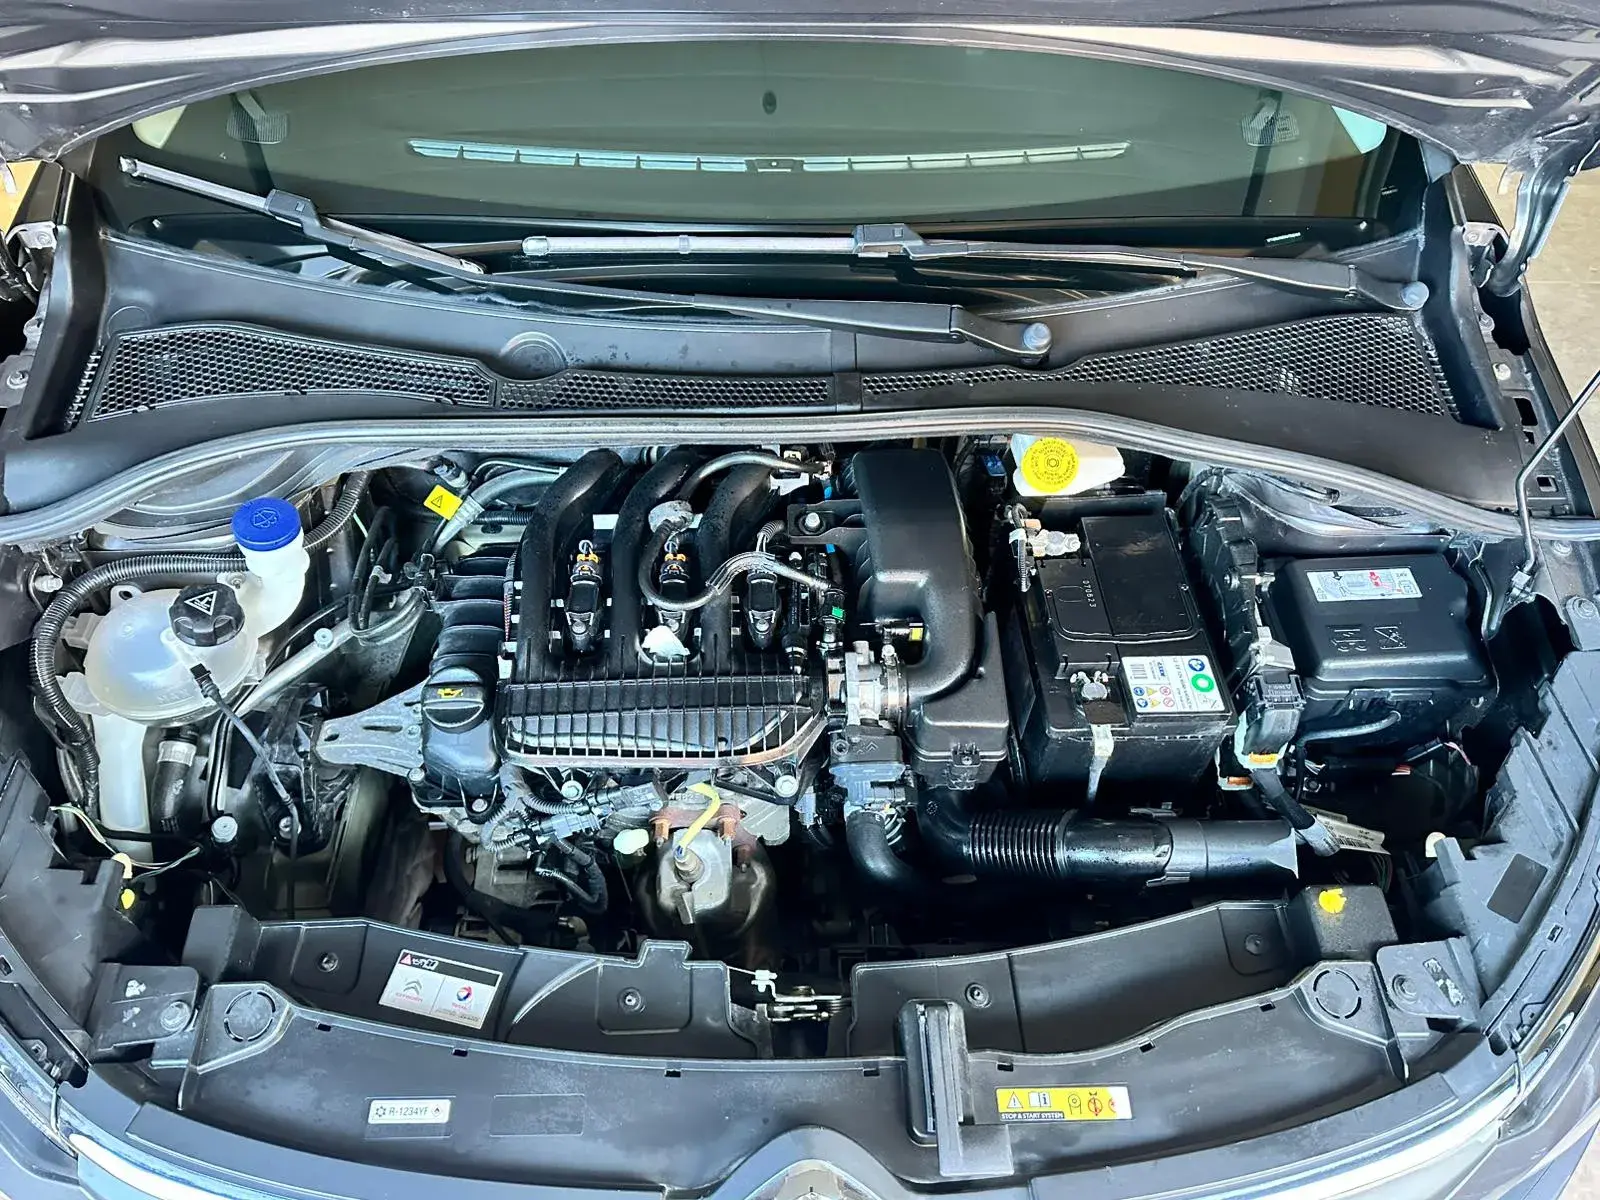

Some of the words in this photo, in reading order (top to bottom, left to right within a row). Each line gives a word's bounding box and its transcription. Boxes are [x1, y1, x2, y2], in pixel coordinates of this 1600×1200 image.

[388, 1106, 429, 1117] R-1234YF
[1001, 1112, 1017, 1120] STOP
[1023, 1112, 1040, 1120] START
[1041, 1112, 1064, 1120] SYSTEM
